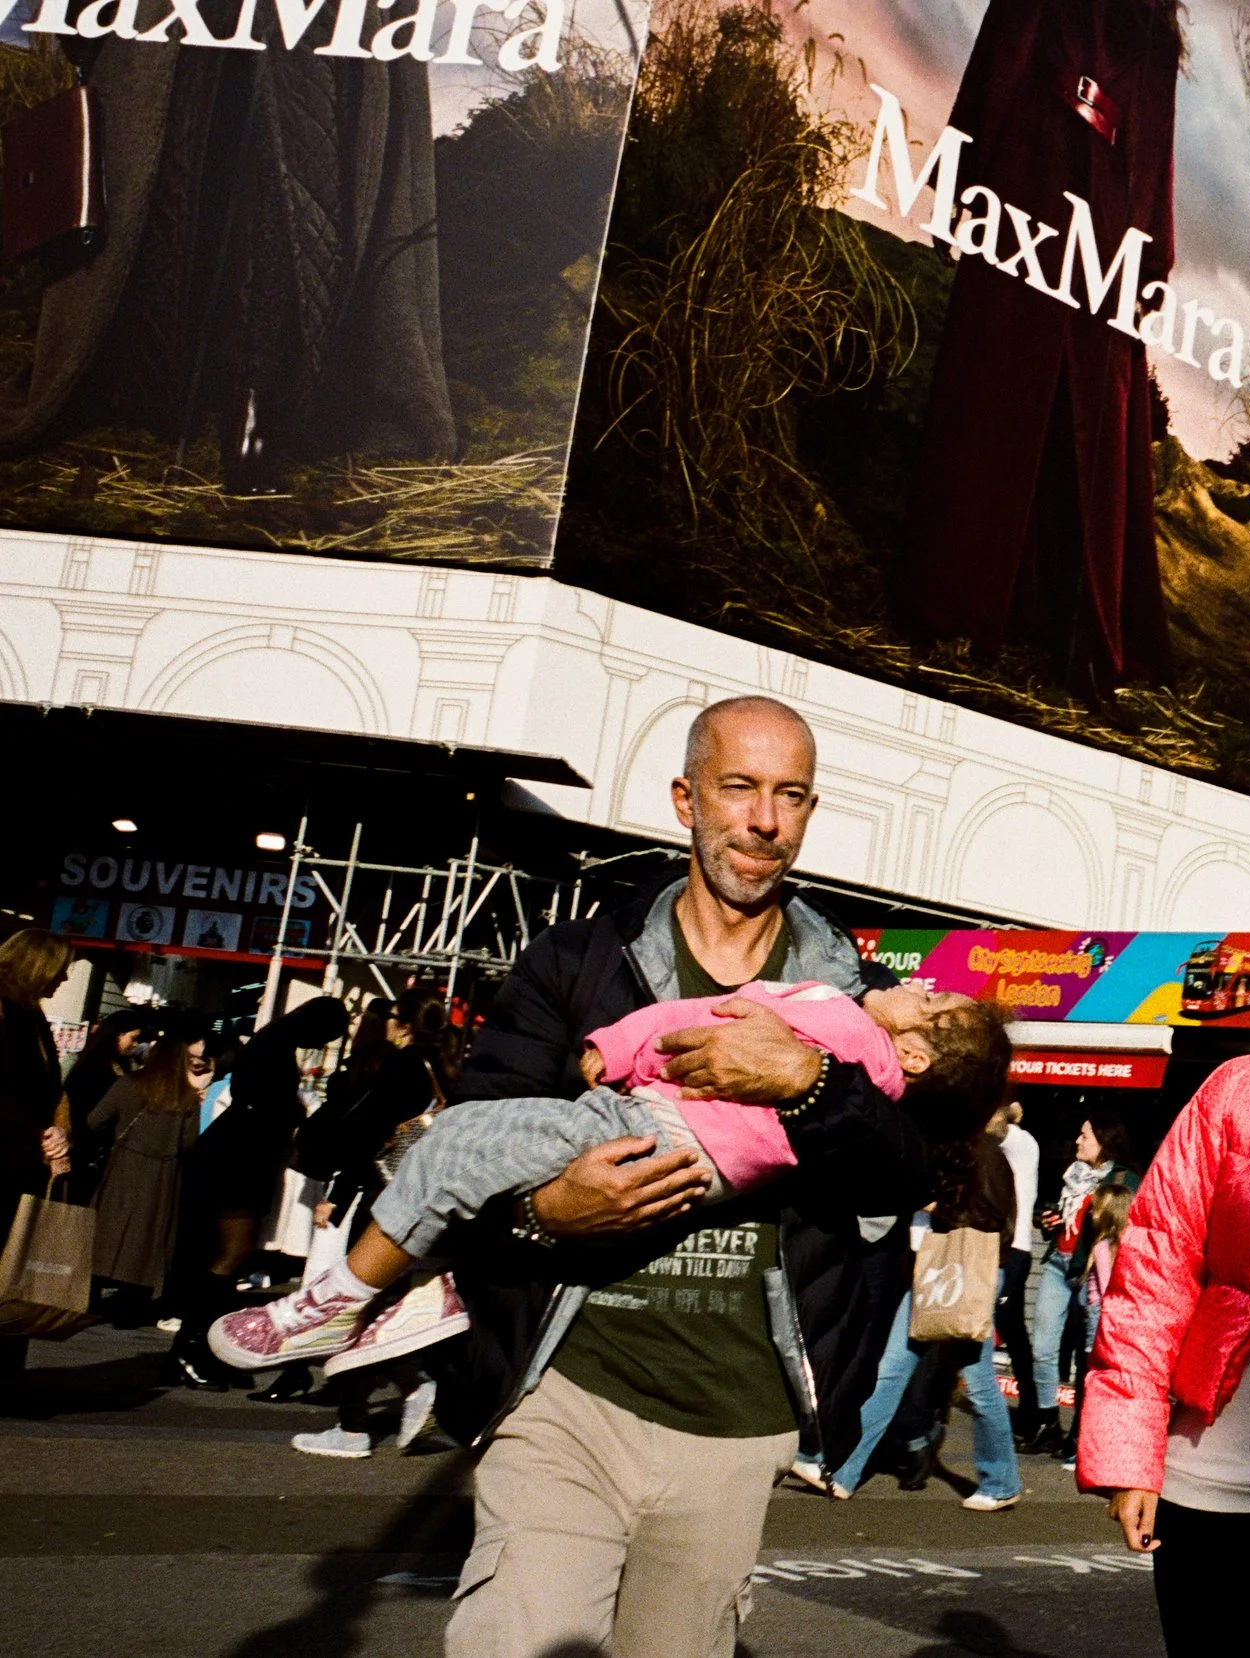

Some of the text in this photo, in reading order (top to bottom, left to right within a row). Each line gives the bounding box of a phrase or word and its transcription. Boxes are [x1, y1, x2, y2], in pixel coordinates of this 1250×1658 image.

[850, 83, 1244, 389] MaxMara
[60, 853, 317, 909] SOUVENIRS
[1045, 1061, 1096, 1077] TICKETS
[1097, 1063, 1133, 1078] HERE
[638, 1256, 683, 1277] OWN
